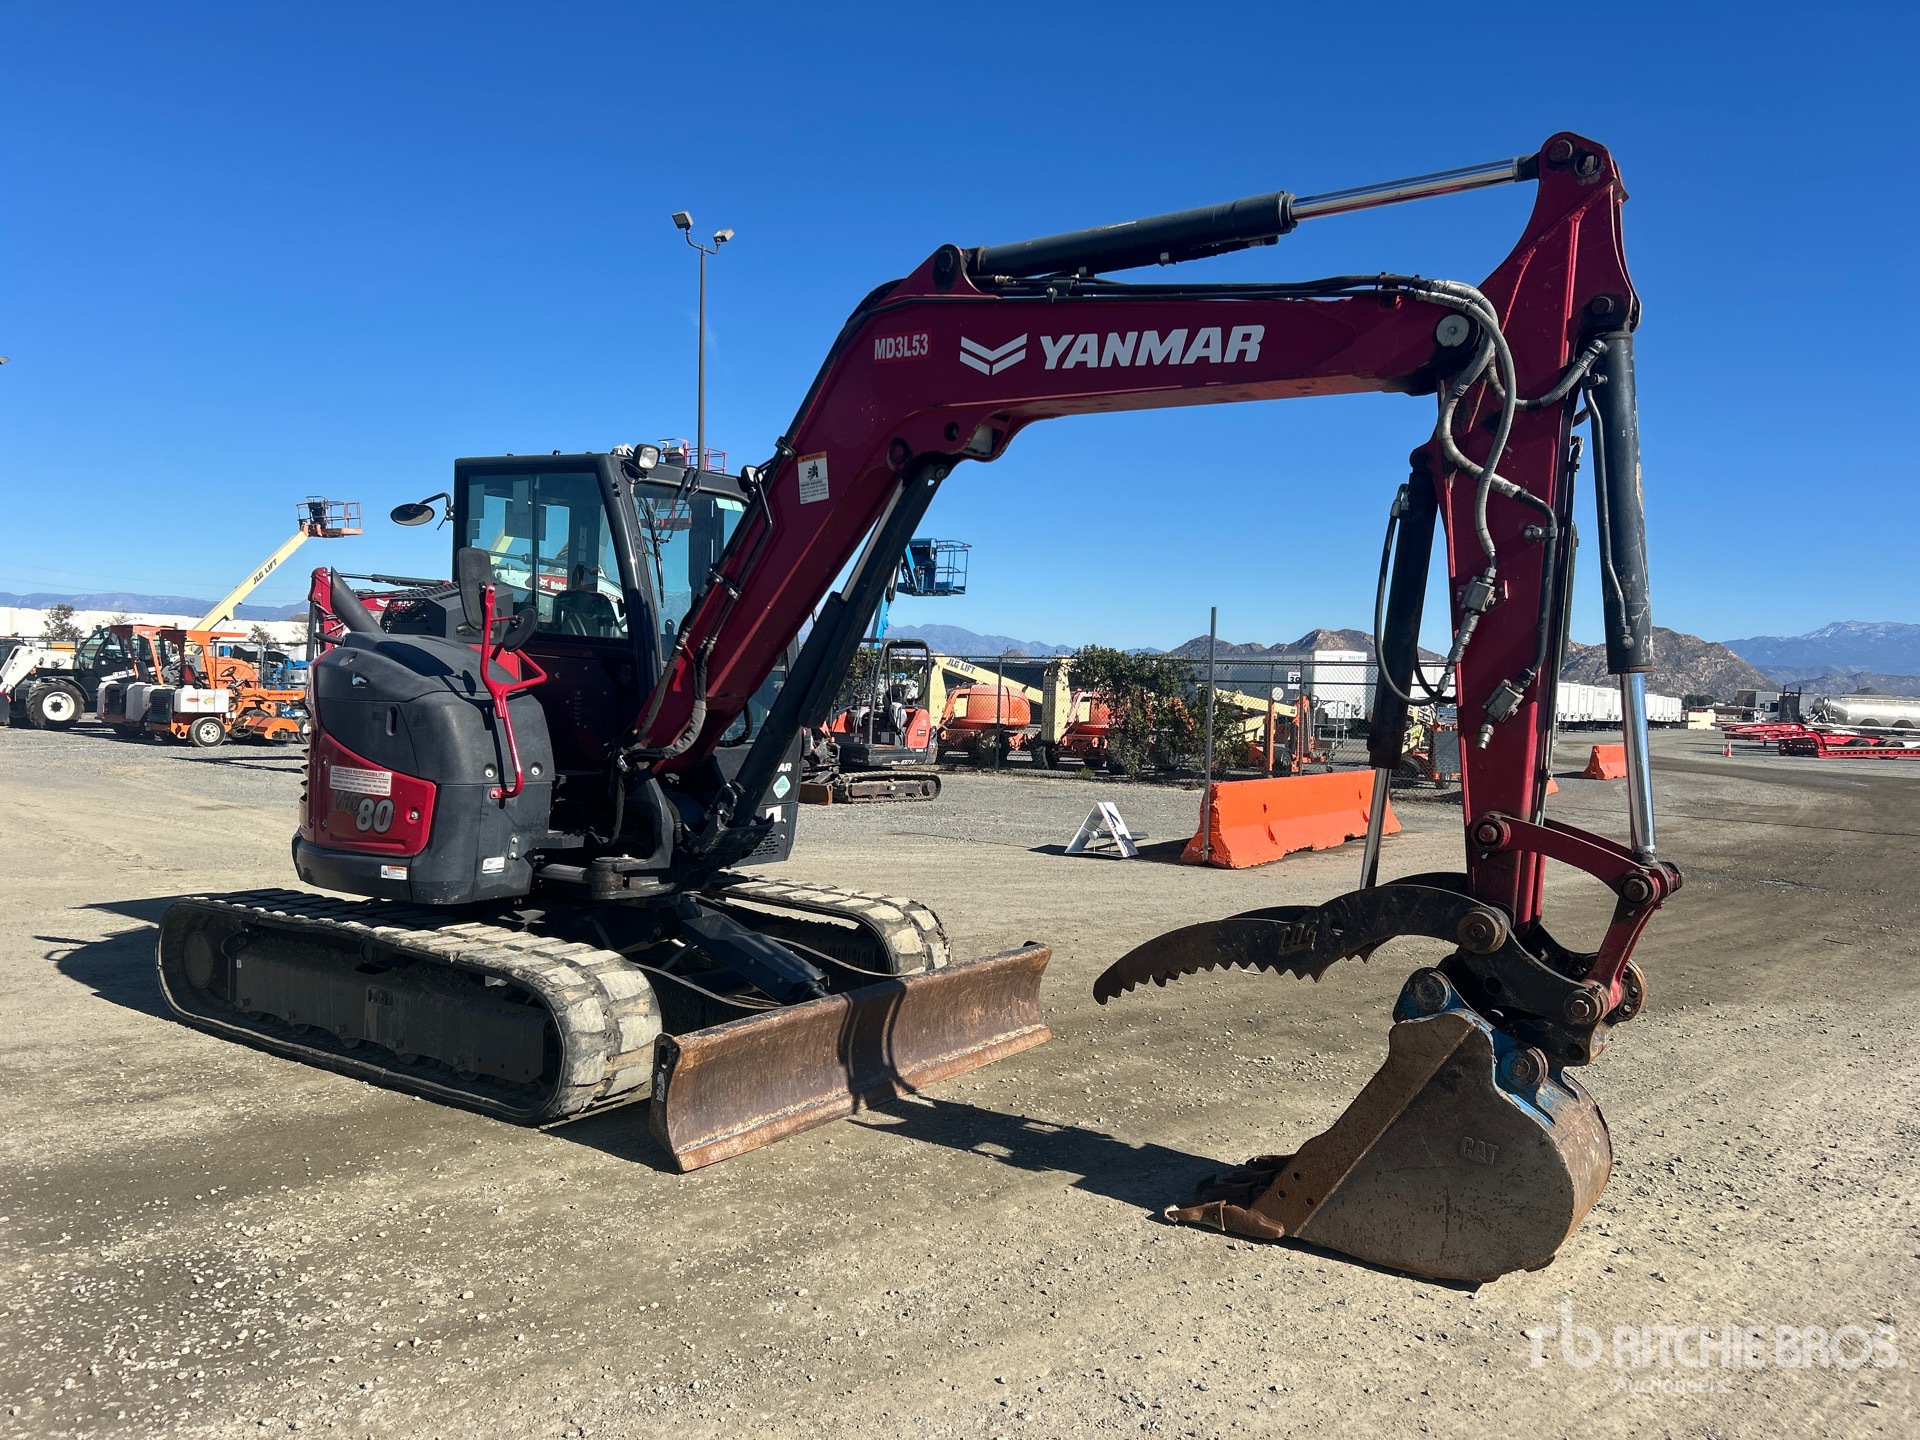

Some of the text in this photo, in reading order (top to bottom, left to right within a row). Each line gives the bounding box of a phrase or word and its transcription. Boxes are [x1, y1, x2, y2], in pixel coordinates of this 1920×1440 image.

[874, 333, 929, 361] MD3L53
[1040, 325, 1265, 370] YANMAR
[253, 558, 277, 585] JLG LIFT
[550, 581, 567, 590] Bobc
[946, 658, 976, 674] JLG LIFT
[352, 769, 386, 777] RESPONSIBILITY
[1461, 1136, 1499, 1166] CAT
